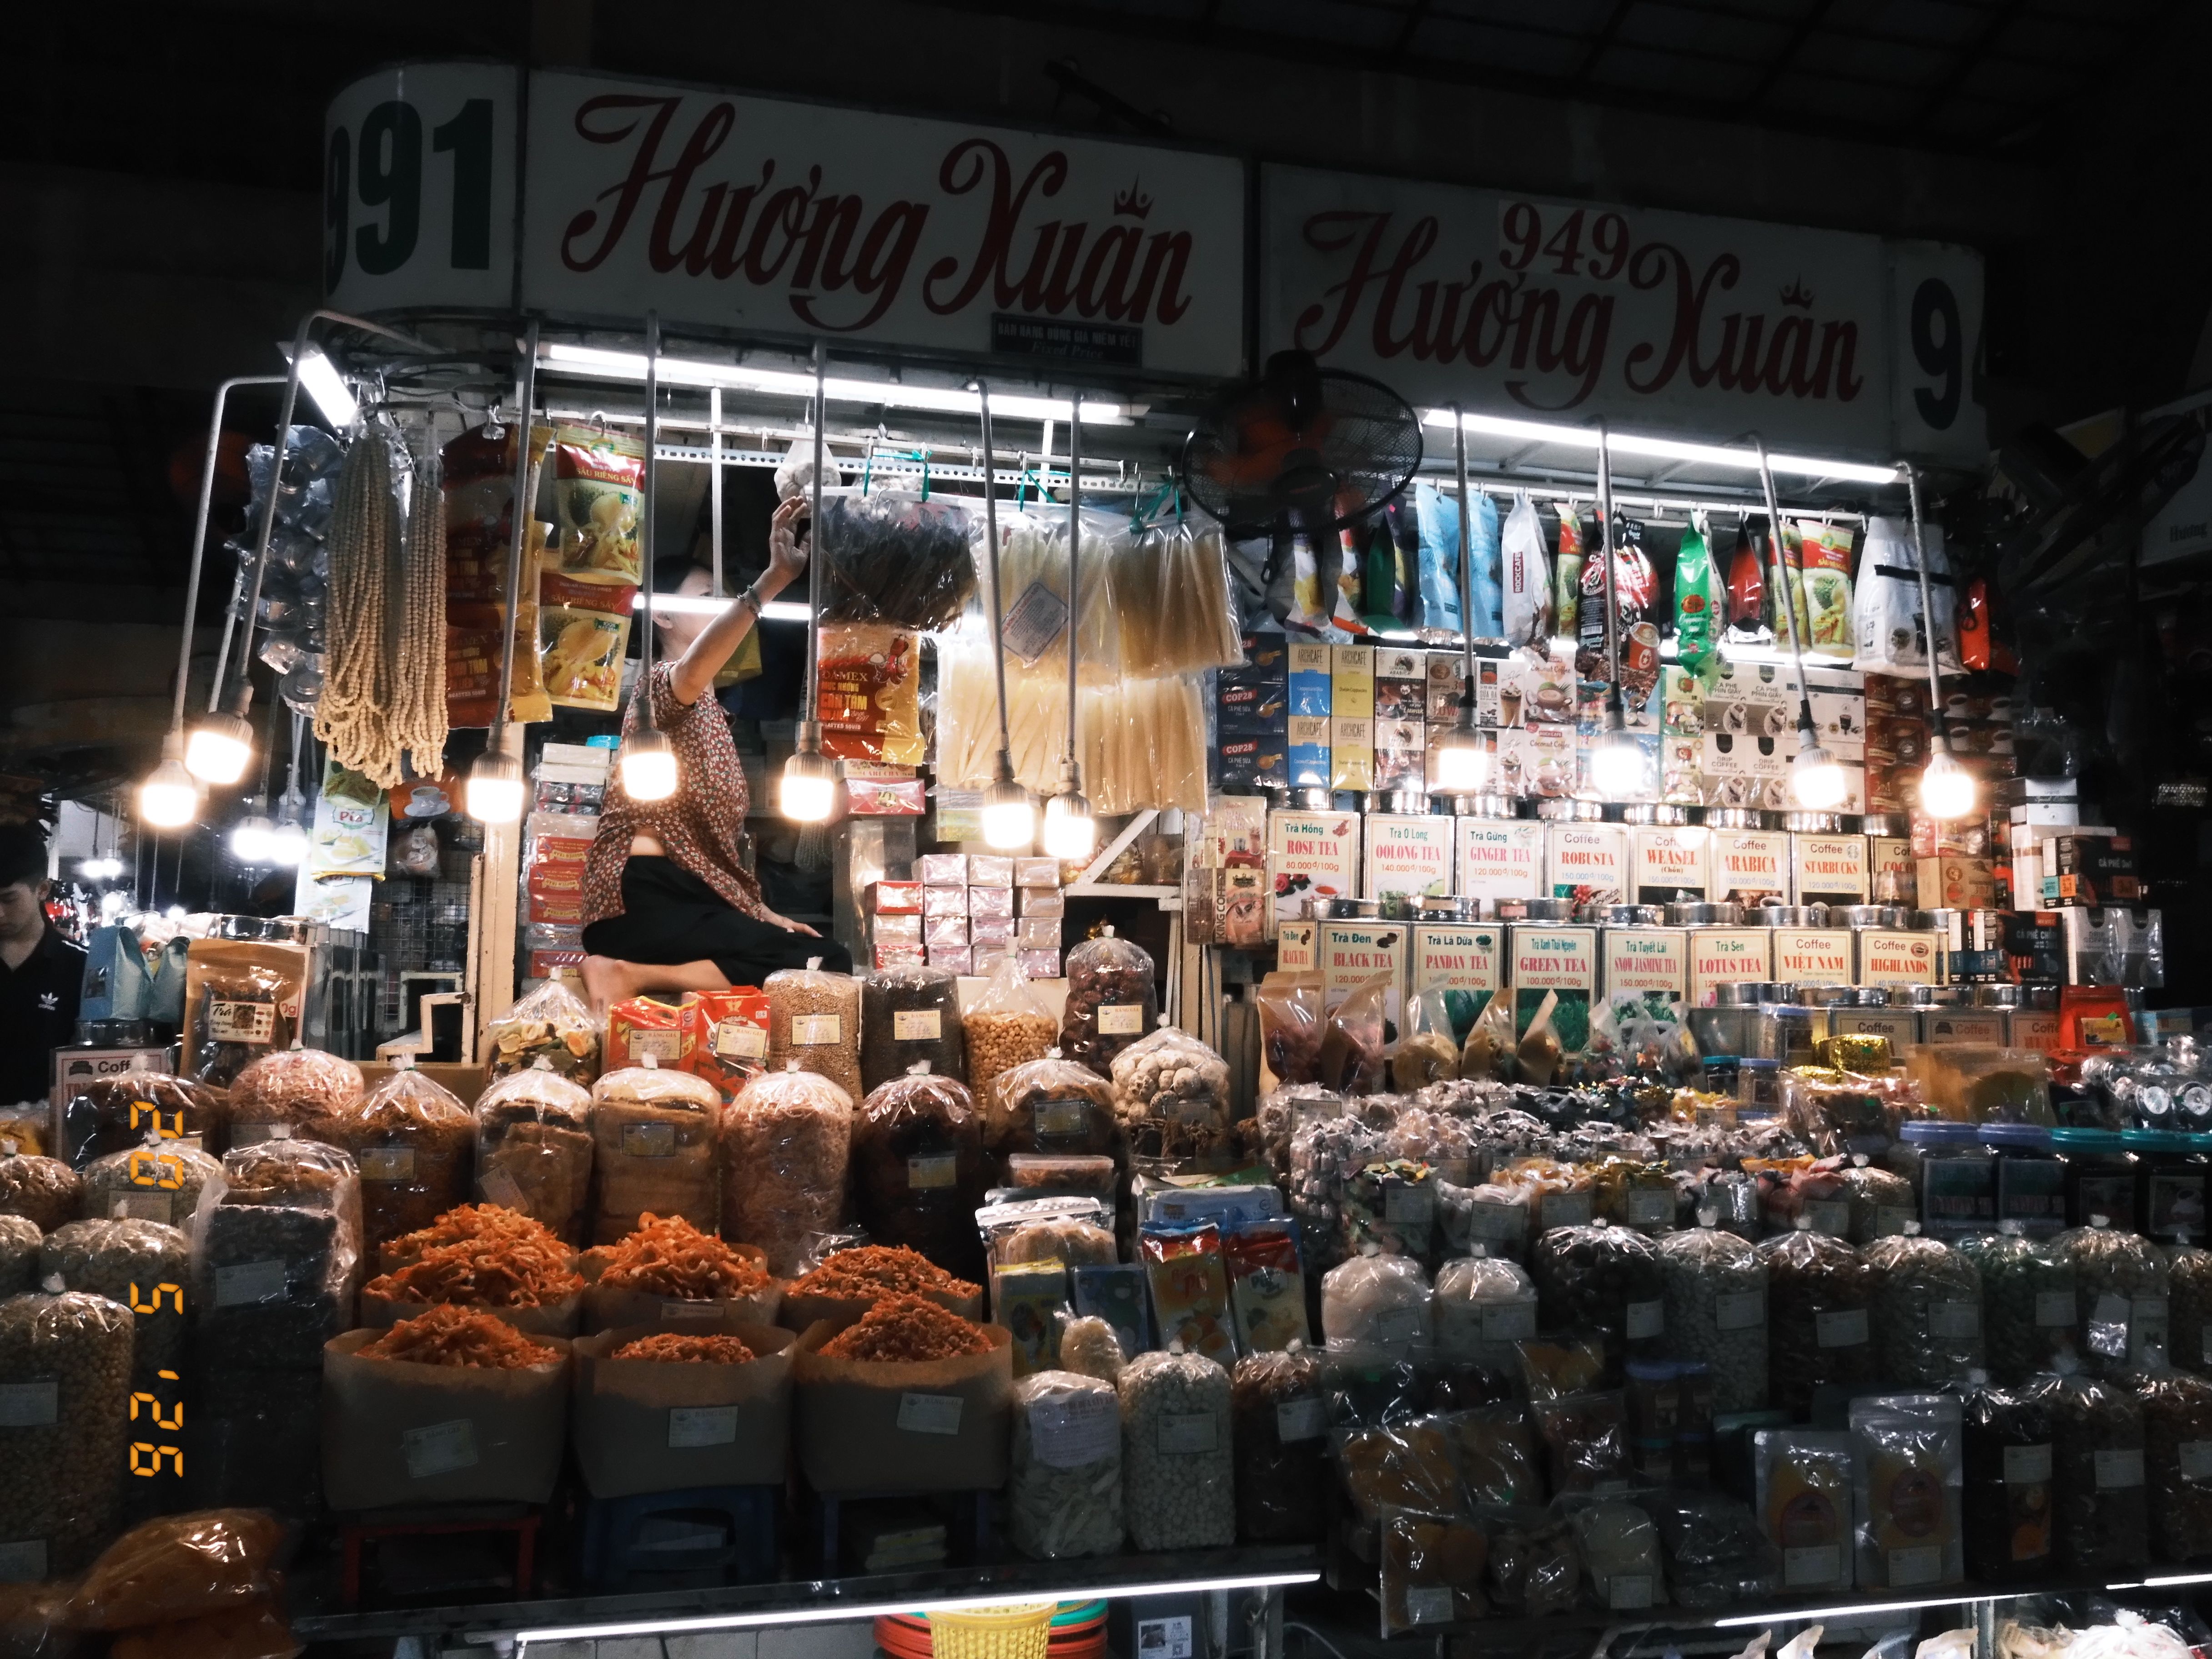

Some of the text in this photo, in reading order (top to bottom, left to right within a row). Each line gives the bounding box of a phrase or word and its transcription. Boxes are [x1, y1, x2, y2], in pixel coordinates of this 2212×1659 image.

[561, 94, 930, 332] Hương
[1500, 202, 1630, 280] 949
[1294, 209, 1616, 411] Hương
[1031, 340, 1104, 358] Fixed Price
[594, 471, 619, 481] RIÊNG
[822, 670, 867, 681] DAMEX
[1554, 665, 1571, 675] Coffee
[1226, 692, 1252, 702] COP28
[1227, 743, 1253, 753] COP28
[1553, 740, 1570, 749] Coffee
[1285, 824, 1323, 835] Trà Hồng
[1390, 827, 1402, 839] Trà
[1411, 828, 1428, 840] Long
[1471, 830, 1507, 843] Trà Gừng
[1564, 833, 1600, 845] Coffee
[1287, 840, 1339, 856] ROSE TEA
[1733, 840, 1766, 851] Coffee
[1810, 843, 1842, 855] Coffee
[1376, 845, 1440, 861] OOLONG TEA
[1470, 846, 1531, 862] GINGER TEA
[1561, 851, 1614, 866] ROBUSTA
[1647, 849, 1698, 865] WEASEL
[1725, 855, 1776, 873] ARABICA
[1805, 860, 1858, 875] STARBUCKS
[1216, 914, 1227, 940] KING
[1291, 931, 1299, 941] Đen
[1332, 932, 1371, 944] Trà Đen
[1428, 935, 1472, 946] Trà Lá Dứa
[1626, 940, 1667, 955] Trà Tuyết Lài
[1716, 941, 1744, 952] Trà Sen
[1796, 938, 1831, 950] Coffee
[1874, 940, 1906, 951] Coffee
[1282, 950, 1308, 965] BLACK TEA
[1333, 953, 1393, 968] BLACK TEA
[1426, 955, 1488, 970] PANDAN TEA
[1784, 953, 1844, 973] VIỆT NAM
[1520, 957, 1587, 972] GREEN TEA
[1614, 958, 1677, 974] SNOW JASMINE TEA
[1699, 958, 1761, 973] LOTUS TEA
[1870, 958, 1928, 973] HIGHLANDS
[211, 1003, 231, 1016] Trà
[1858, 1022, 1895, 1033] Coffee
[1956, 1024, 1990, 1036] Coffee
[2032, 1023, 2059, 1033] Coffe
[98, 1061, 131, 1073] Coff
